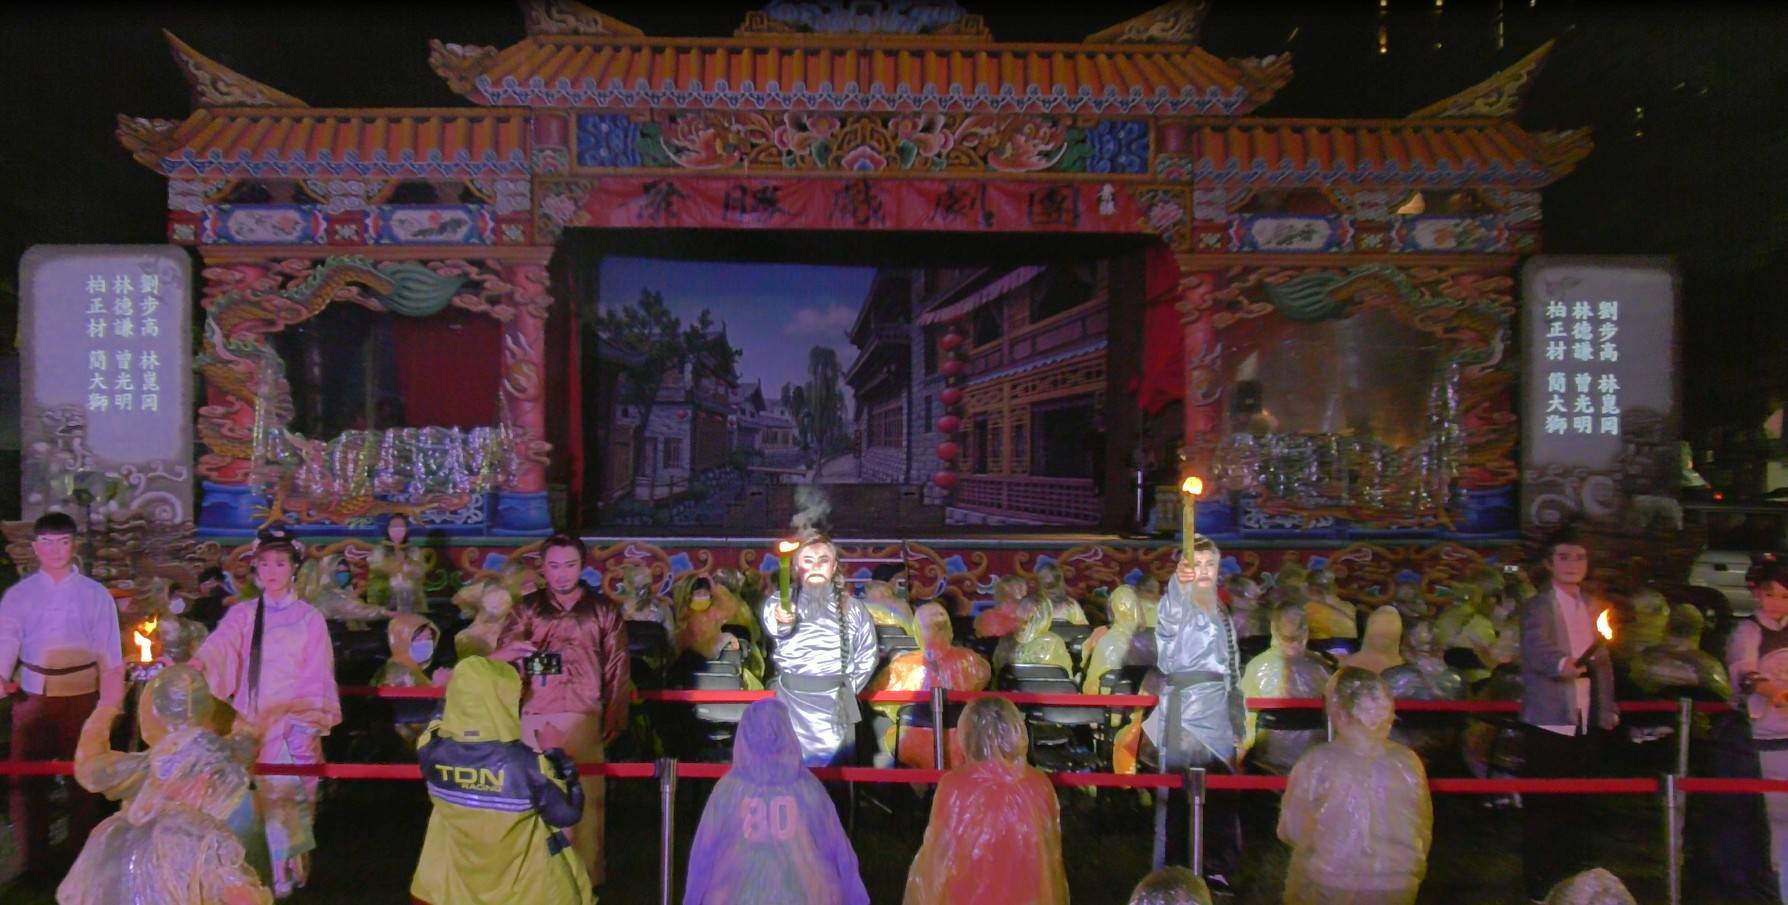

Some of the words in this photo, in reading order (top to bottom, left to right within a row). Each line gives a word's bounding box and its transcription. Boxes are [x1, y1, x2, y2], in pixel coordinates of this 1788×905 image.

[86, 274, 108, 338] 柏正材
[112, 274, 135, 338] 林德謙
[140, 274, 160, 337] 劉步高
[1546, 301, 1568, 361] 柏正材
[1572, 301, 1594, 362] 林德謙
[1598, 301, 1618, 362] 劉步高
[88, 349, 109, 412] 簡大獅
[113, 349, 135, 411] 曾光明
[1545, 372, 1568, 435] 簡大獅
[1573, 373, 1595, 434] 曾光明
[434, 764, 505, 787] TDN
[742, 795, 798, 842] 80
